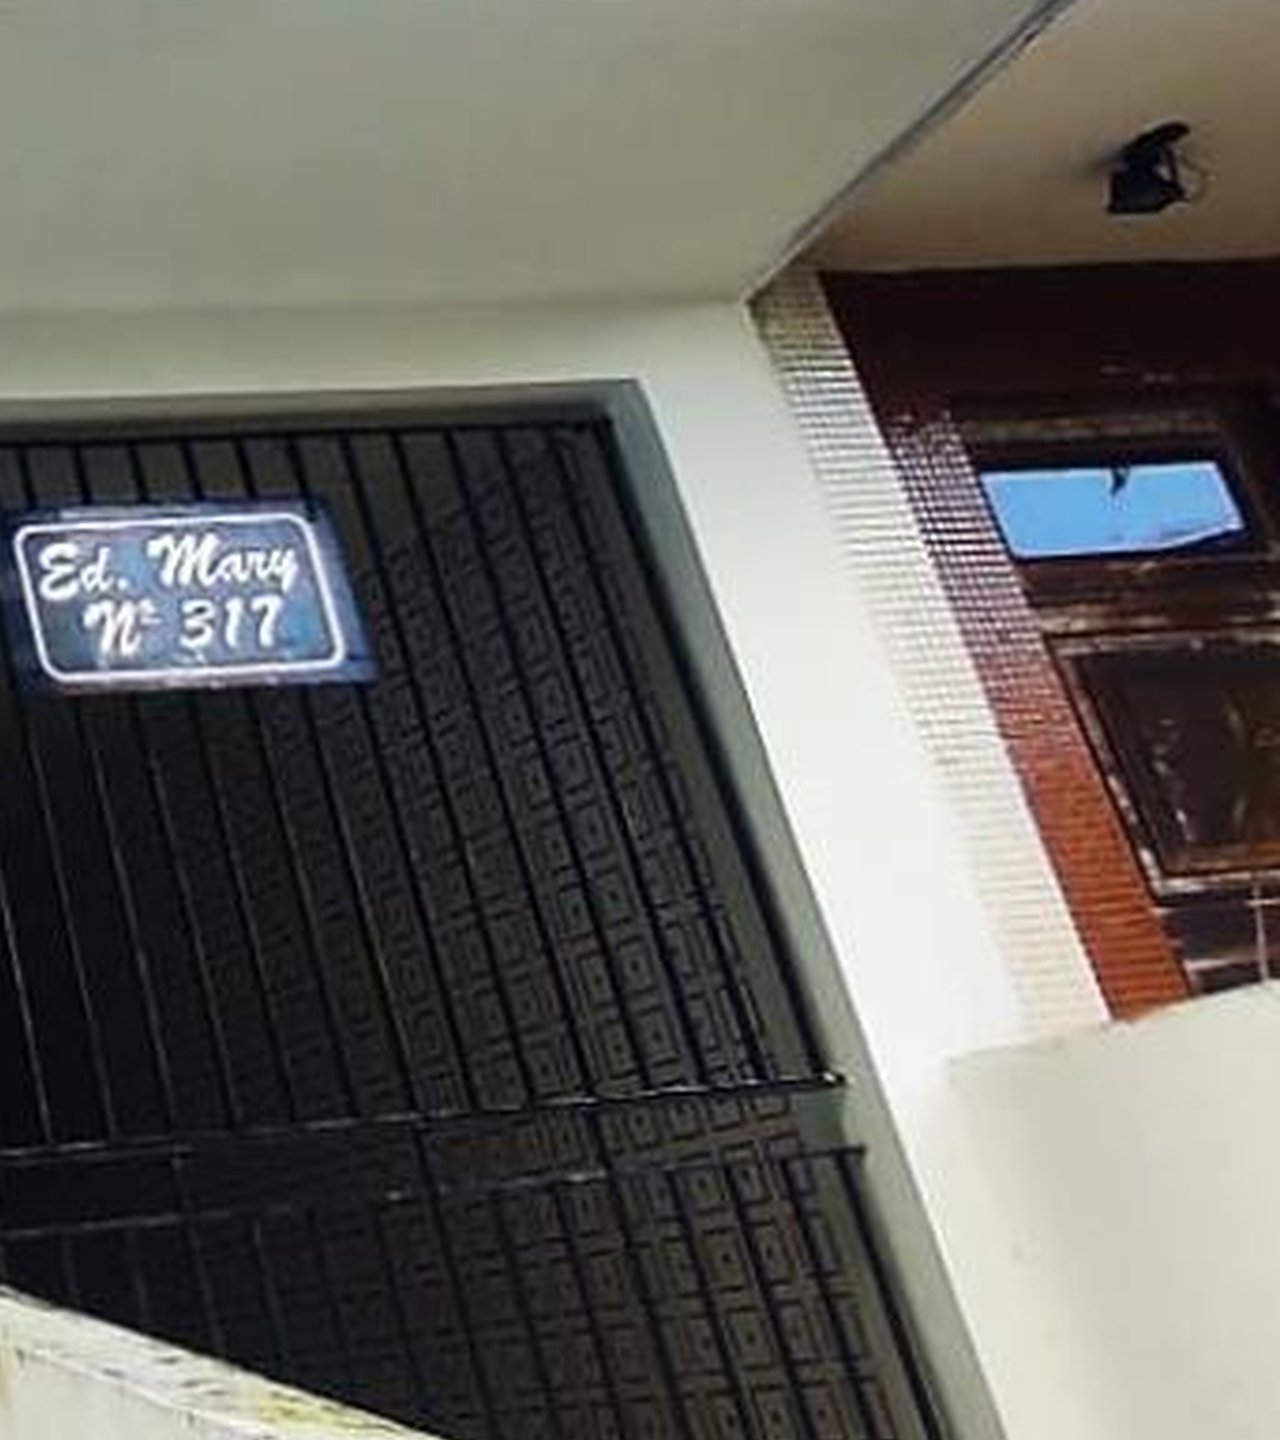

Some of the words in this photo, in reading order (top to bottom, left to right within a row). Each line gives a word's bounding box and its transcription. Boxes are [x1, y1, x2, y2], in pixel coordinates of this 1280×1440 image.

[39, 542, 129, 602] Ed.
[146, 531, 299, 591] Mary
[179, 595, 283, 650] 317
